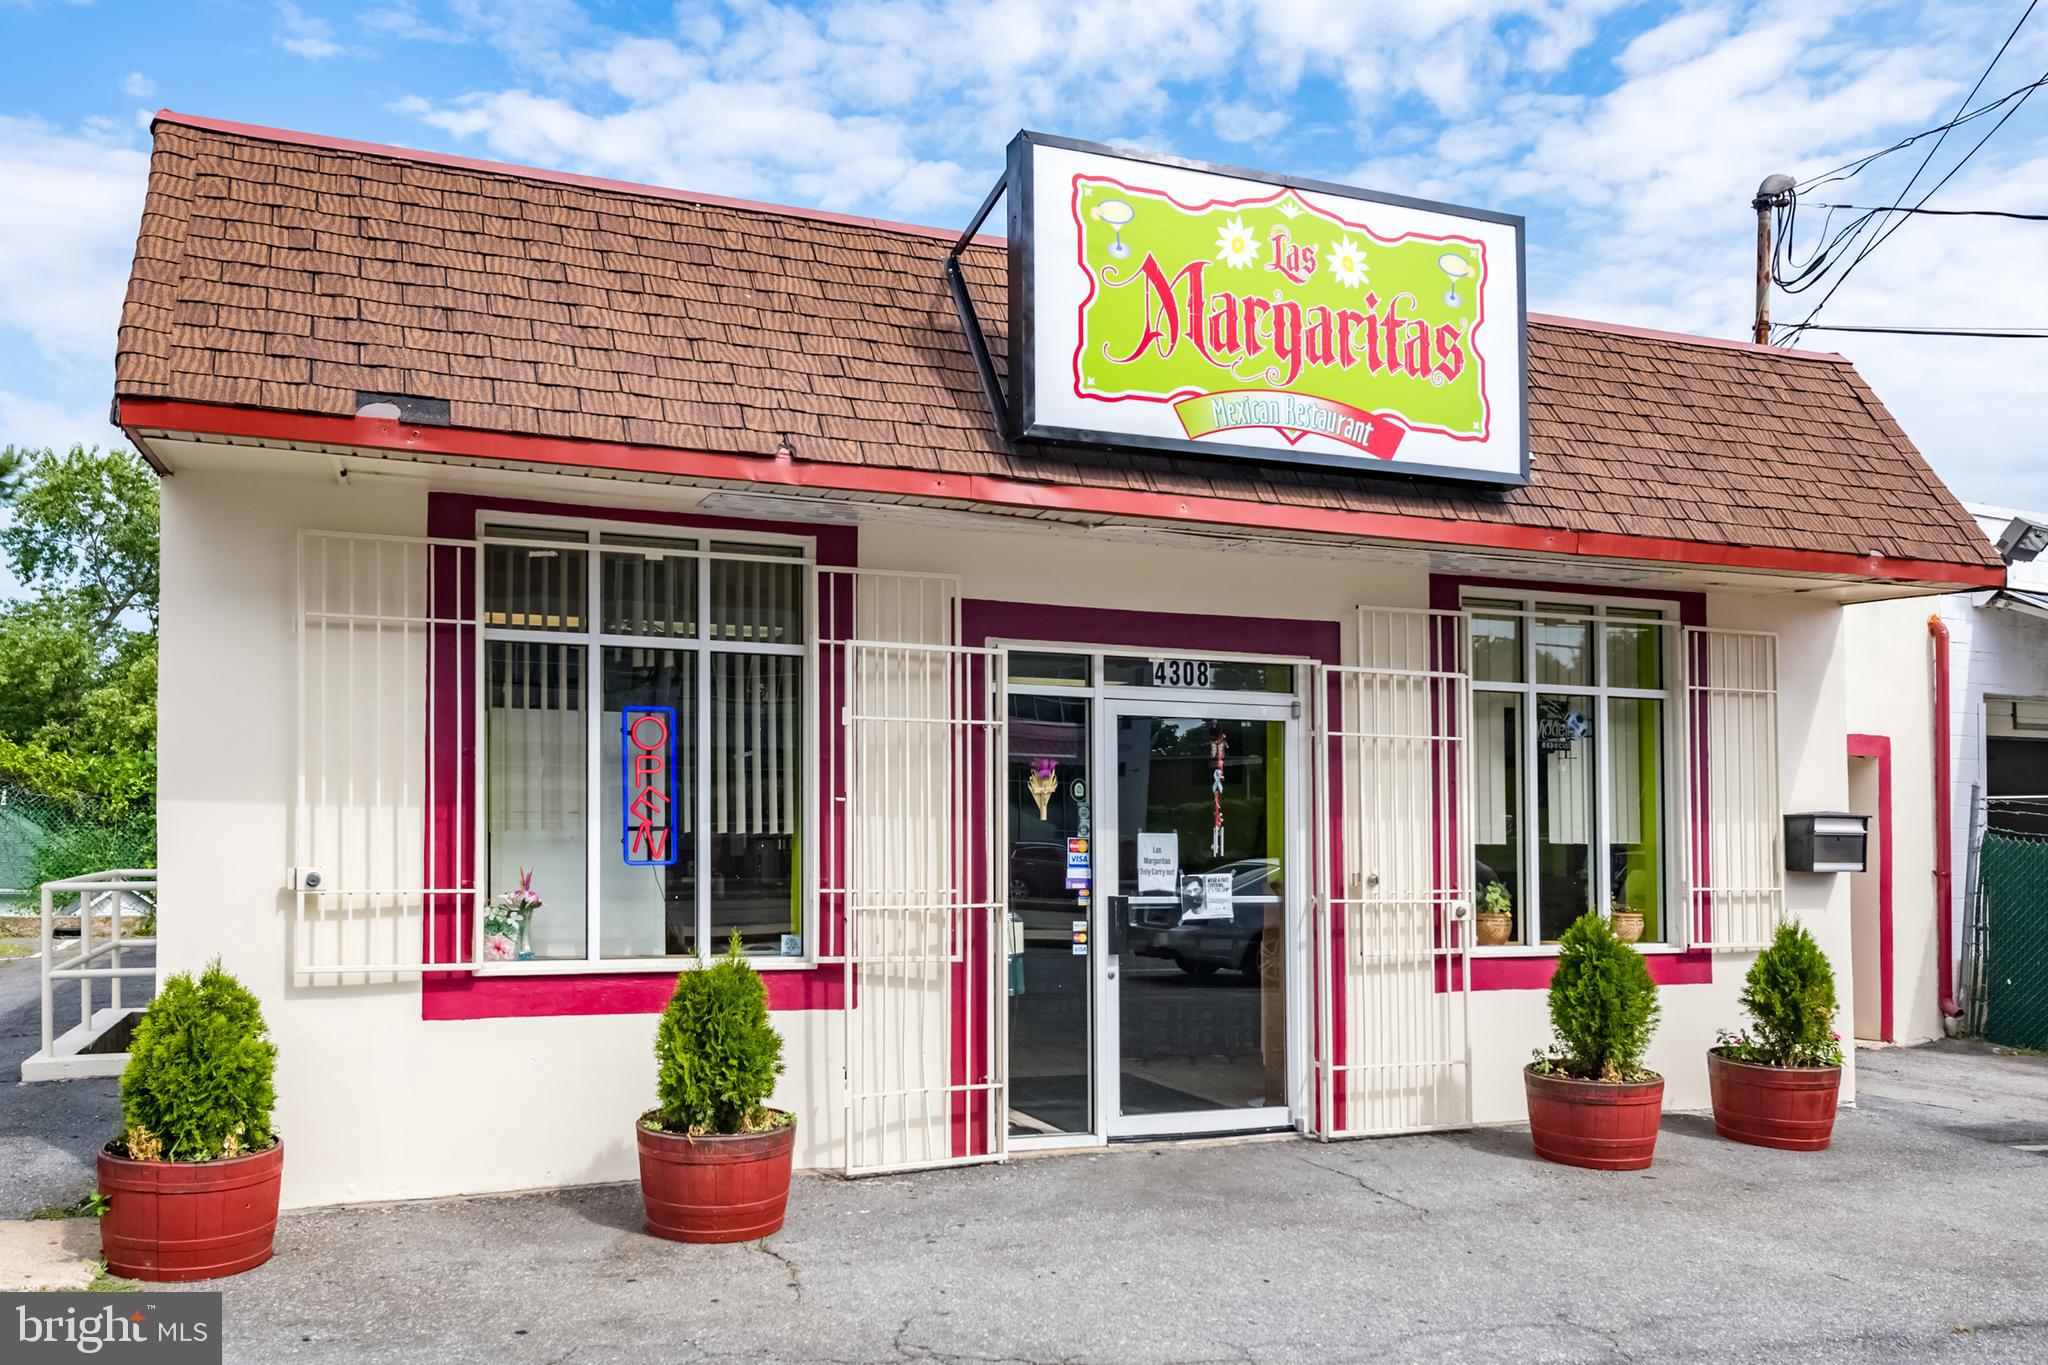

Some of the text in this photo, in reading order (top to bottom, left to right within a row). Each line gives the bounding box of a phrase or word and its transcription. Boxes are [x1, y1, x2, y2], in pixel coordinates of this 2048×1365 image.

[1265, 226, 1318, 285] Las
[1101, 250, 1467, 386] Margaritas
[1212, 395, 1375, 448] Mexican Restaurant
[1155, 660, 1208, 687] 4308
[631, 715, 670, 859] OPEN
[1071, 855, 1088, 863] VISA
[1143, 857, 1171, 866] Margaritas
[1152, 846, 1162, 854] Las
[1139, 868, 1151, 877] Only
[1151, 868, 1165, 877] Carry
